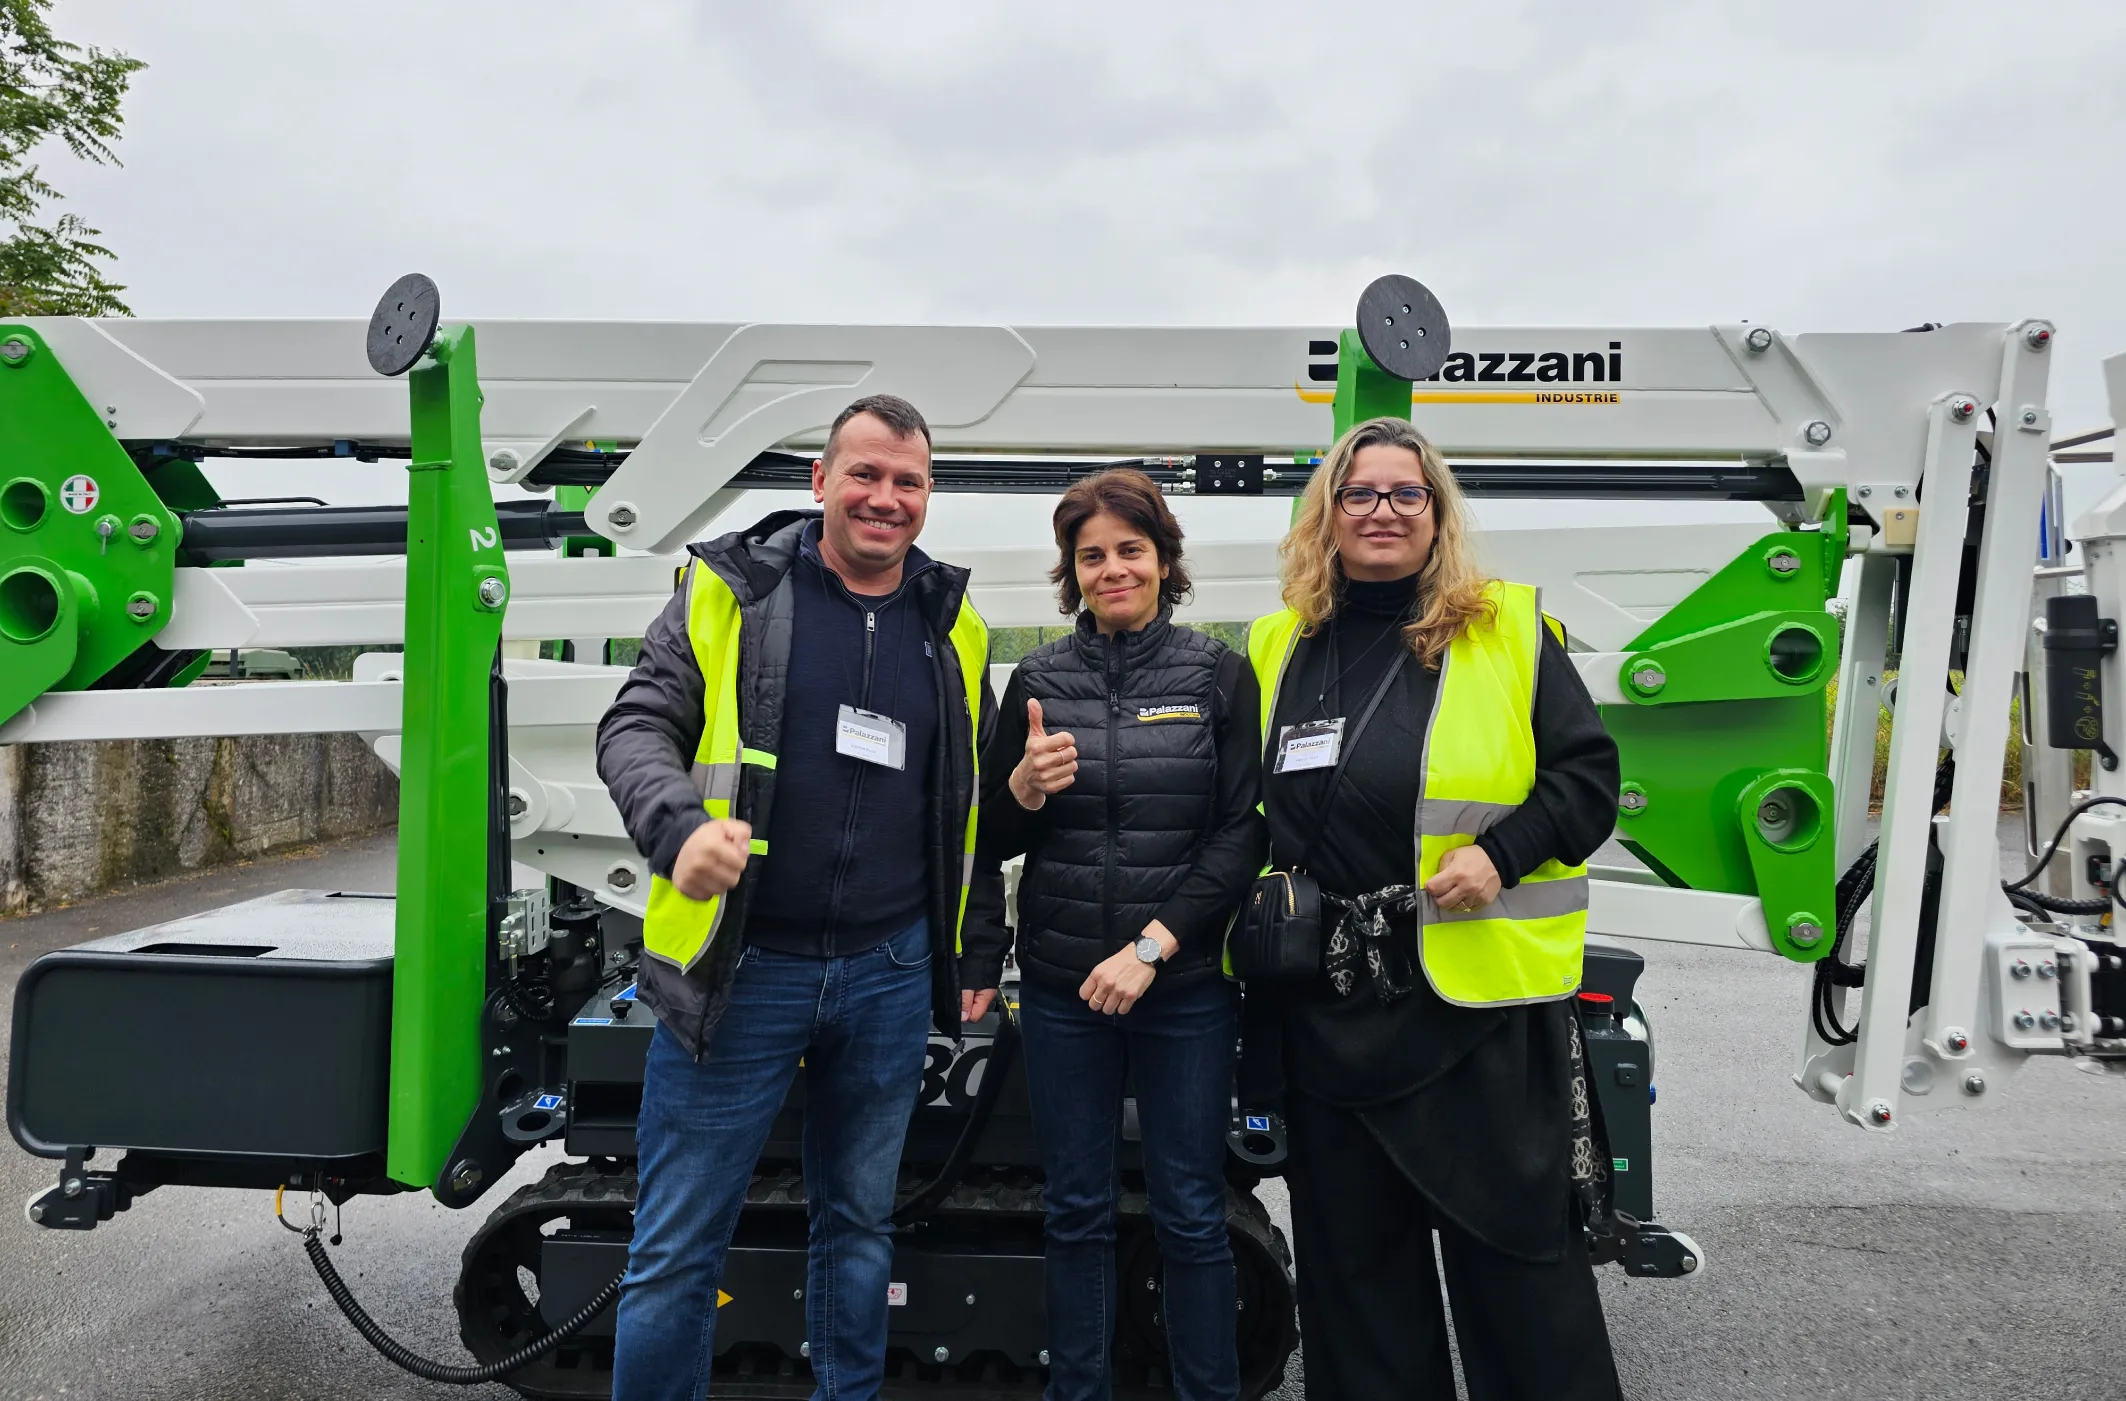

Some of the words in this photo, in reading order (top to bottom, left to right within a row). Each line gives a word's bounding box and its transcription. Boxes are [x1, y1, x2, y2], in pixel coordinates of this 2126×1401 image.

[1420, 341, 1622, 383] azzani
[1536, 393, 1618, 403] INDUSTRIE
[470, 526, 497, 552] 2
[1149, 703, 1199, 716] Palazzani
[849, 727, 887, 743] Palazzani
[1295, 737, 1331, 749] Palazzani
